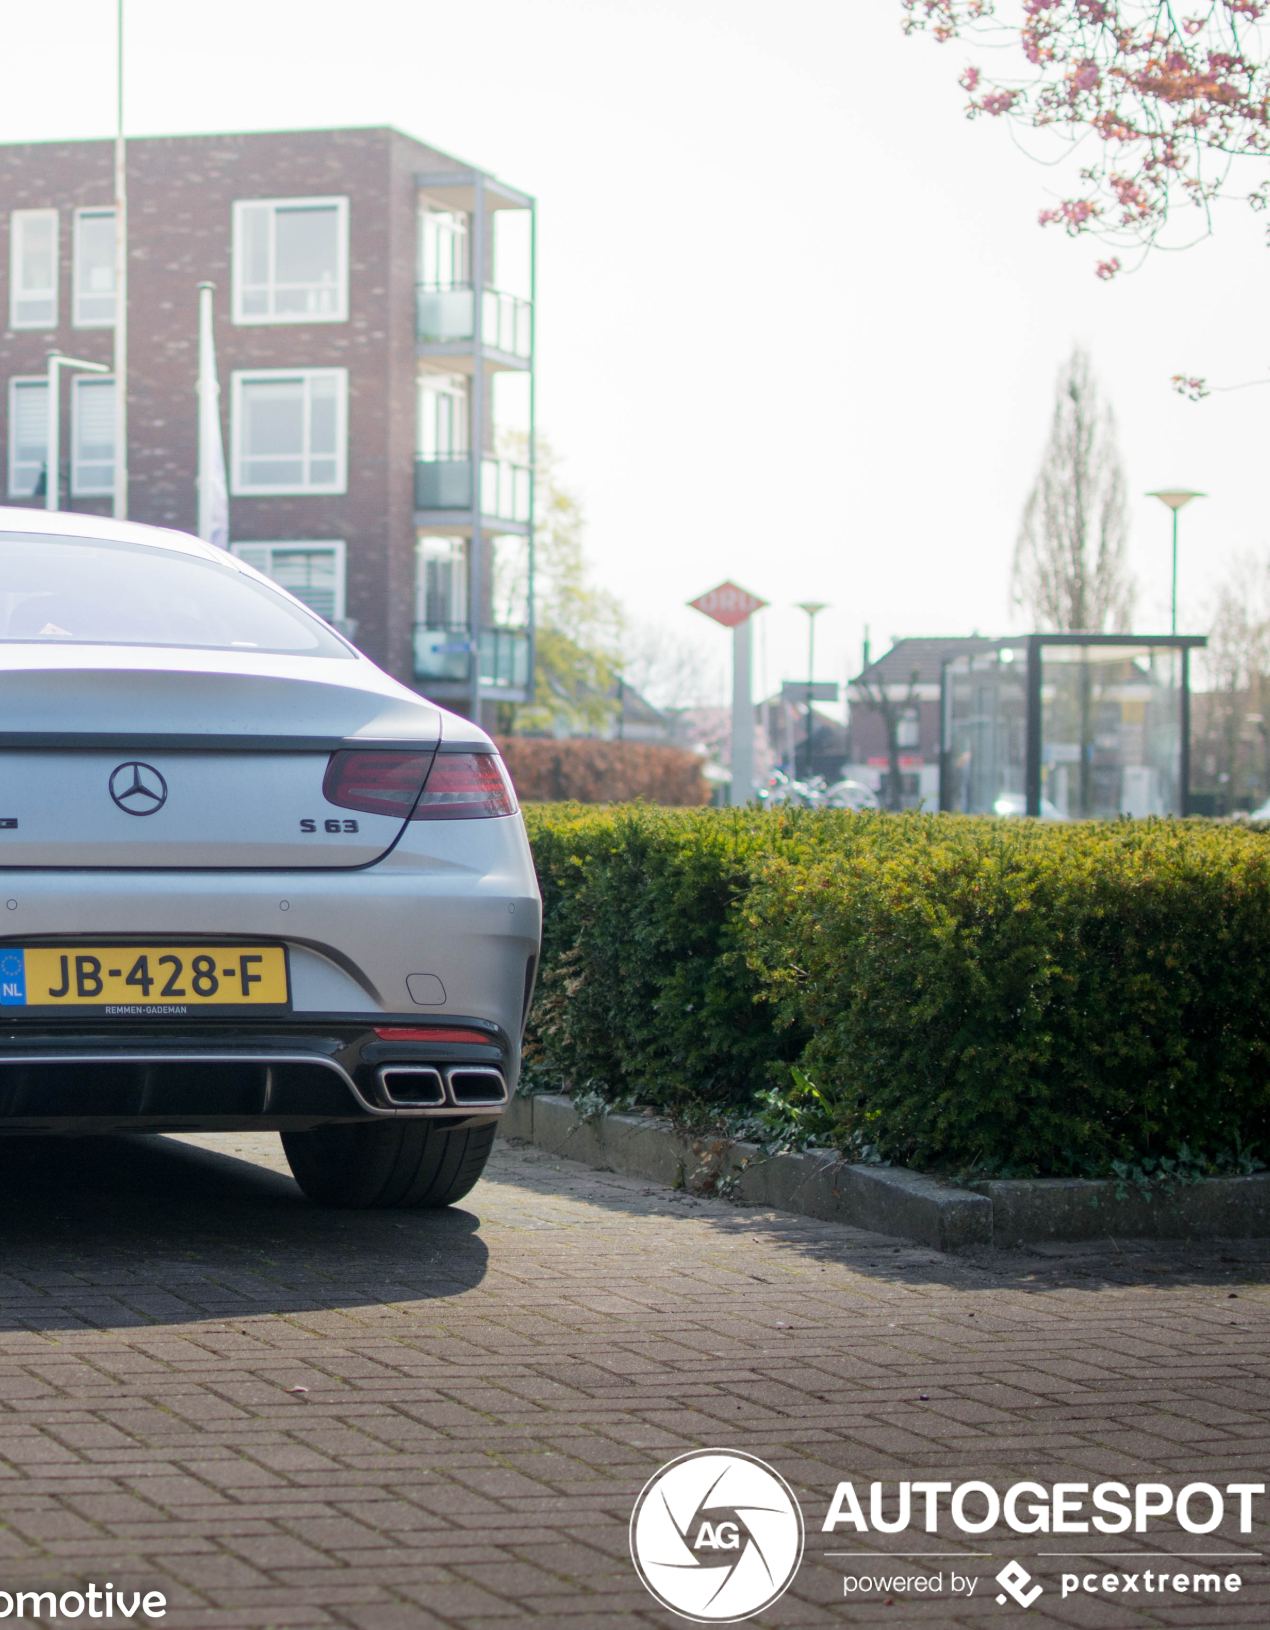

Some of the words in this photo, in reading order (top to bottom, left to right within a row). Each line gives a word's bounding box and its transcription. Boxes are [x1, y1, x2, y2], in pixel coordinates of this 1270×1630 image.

[299, 818, 317, 833] S
[324, 819, 360, 833] 63
[48, 954, 263, 998] JB-428-F
[2, 983, 23, 997] NL
